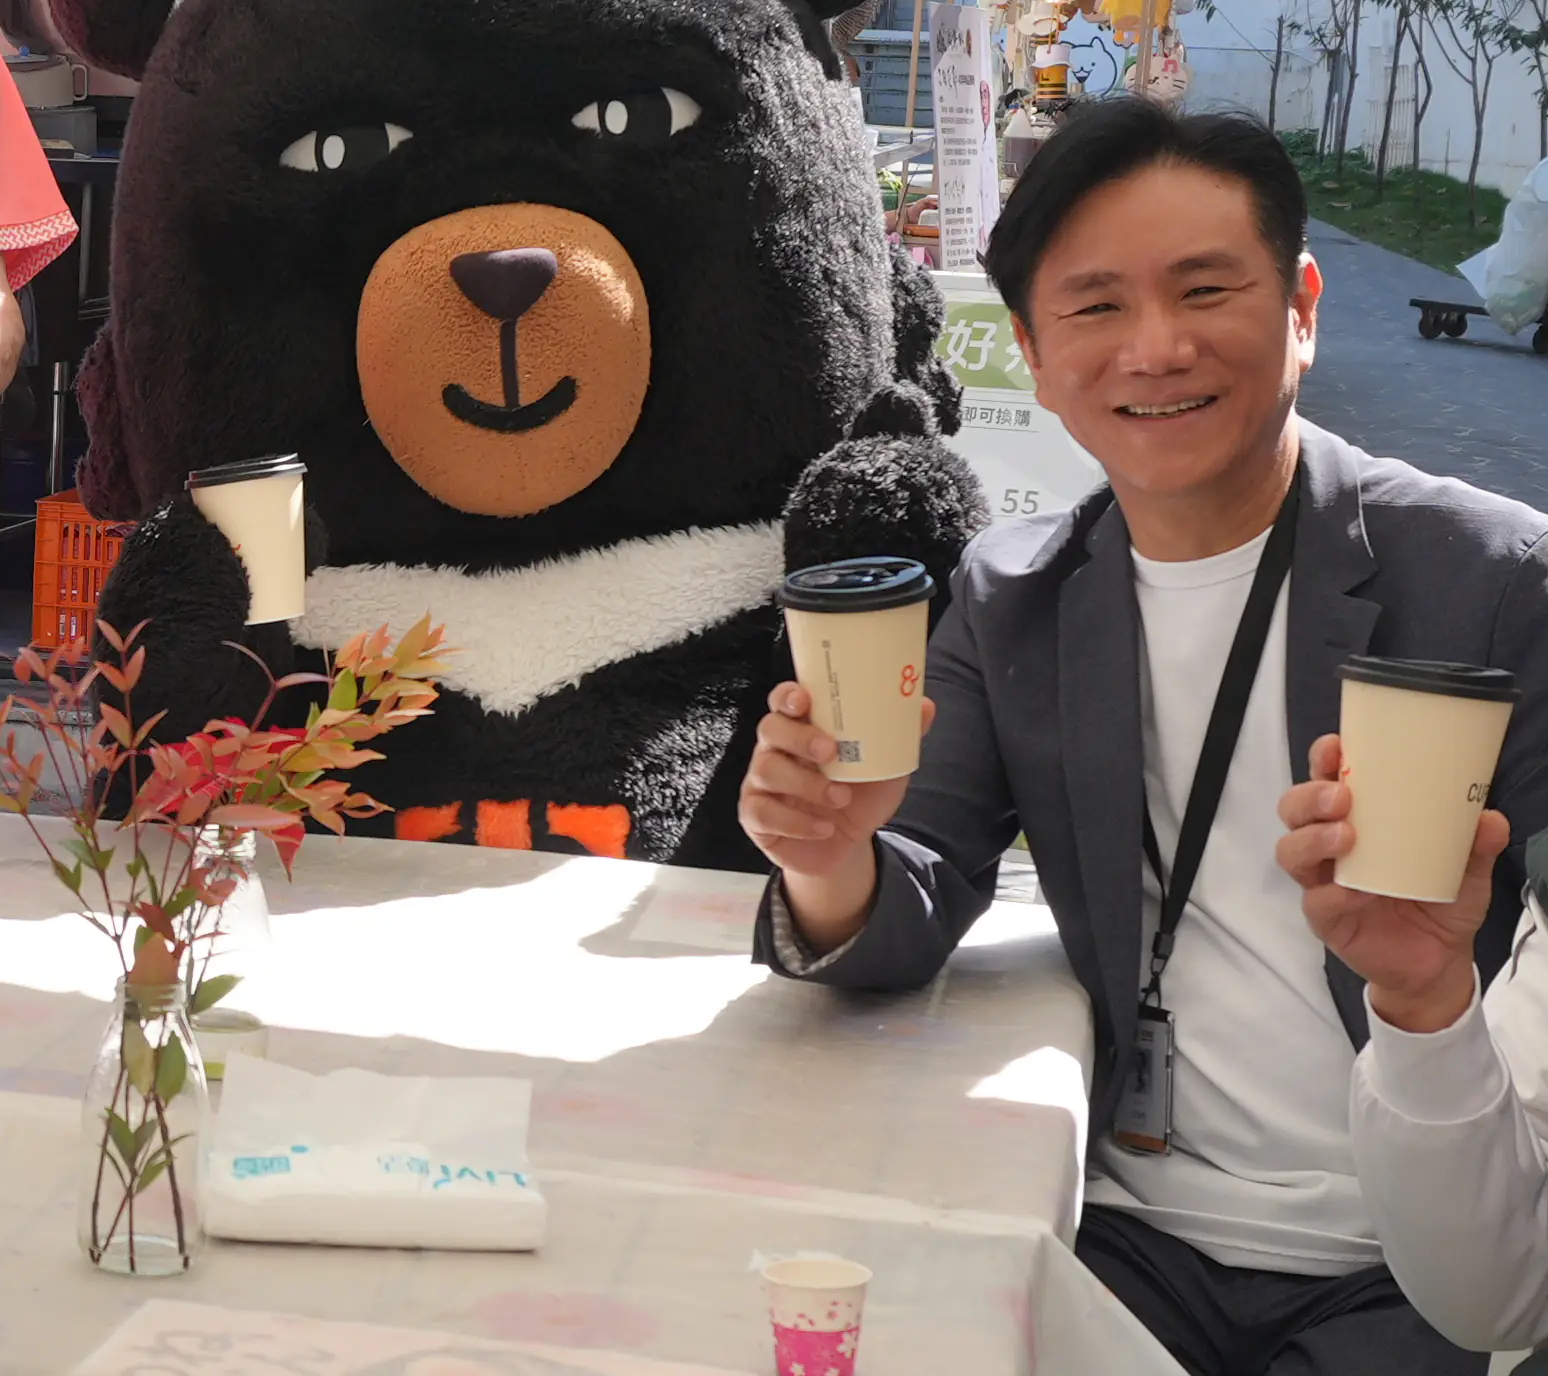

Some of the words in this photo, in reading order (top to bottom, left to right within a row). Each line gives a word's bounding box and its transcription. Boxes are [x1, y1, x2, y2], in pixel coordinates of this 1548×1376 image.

[964, 405, 1032, 427] 即可換購
[1000, 488, 1040, 515] 55
